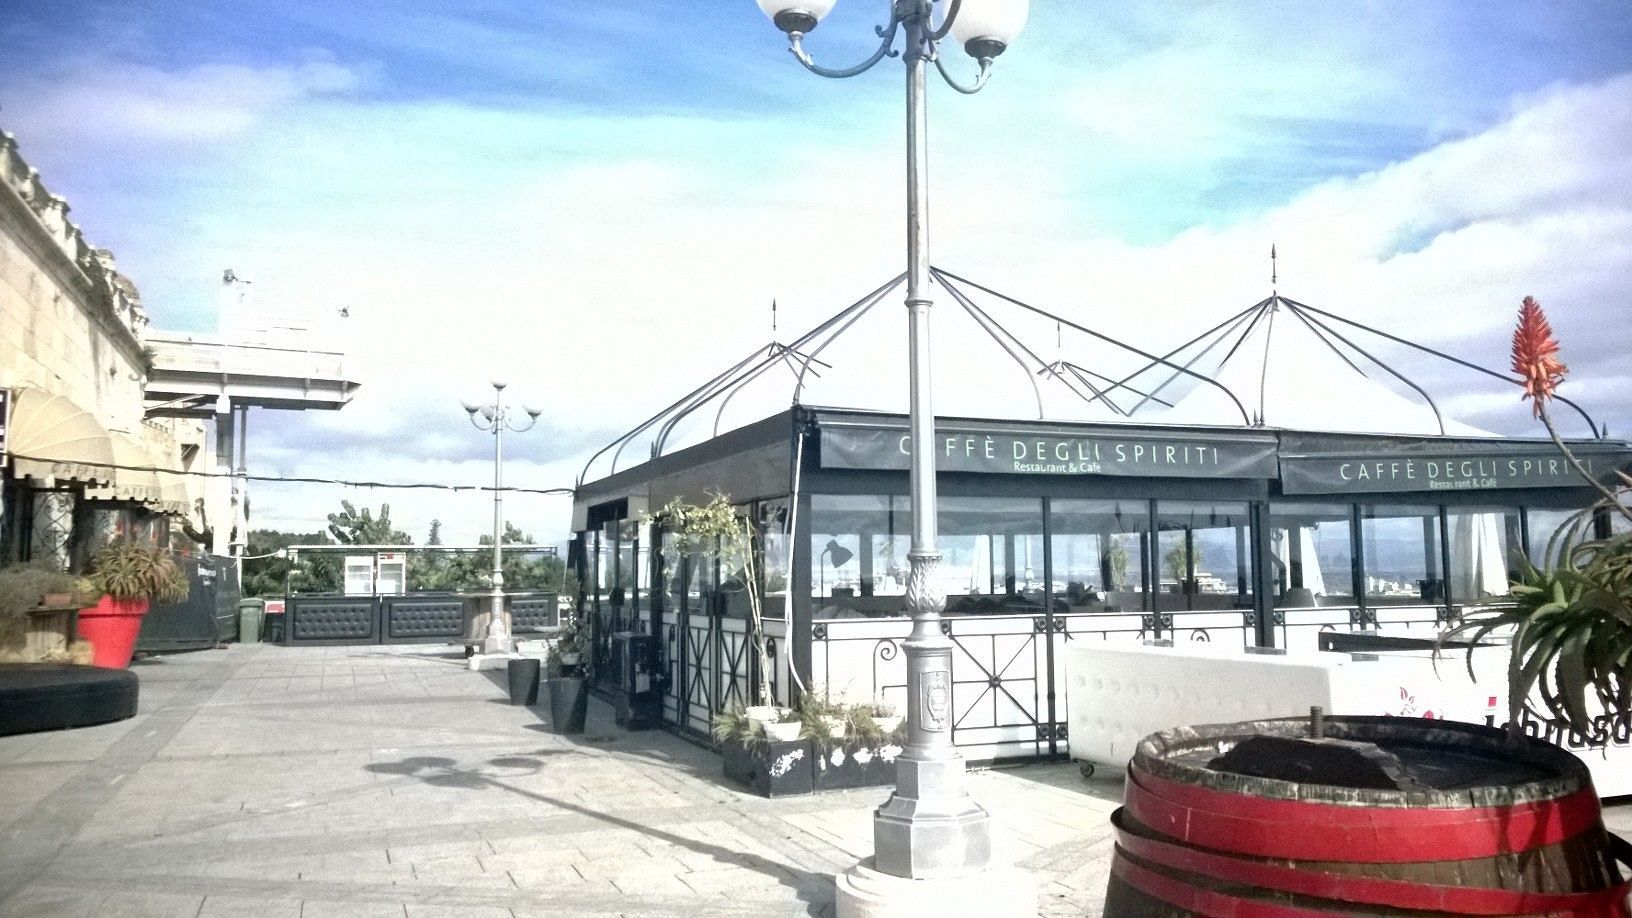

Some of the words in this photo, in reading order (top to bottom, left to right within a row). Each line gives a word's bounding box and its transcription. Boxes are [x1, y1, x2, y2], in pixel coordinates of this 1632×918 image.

[899, 434, 995, 459] CFFÈ
[1013, 440, 1100, 461] DEGLI
[1115, 444, 1217, 465] SPIRITI
[1013, 461, 1066, 472] Restaurant
[1068, 462, 1077, 473] &
[1340, 458, 1416, 480] CAFFÈ
[1427, 460, 1497, 478] DEGLI
